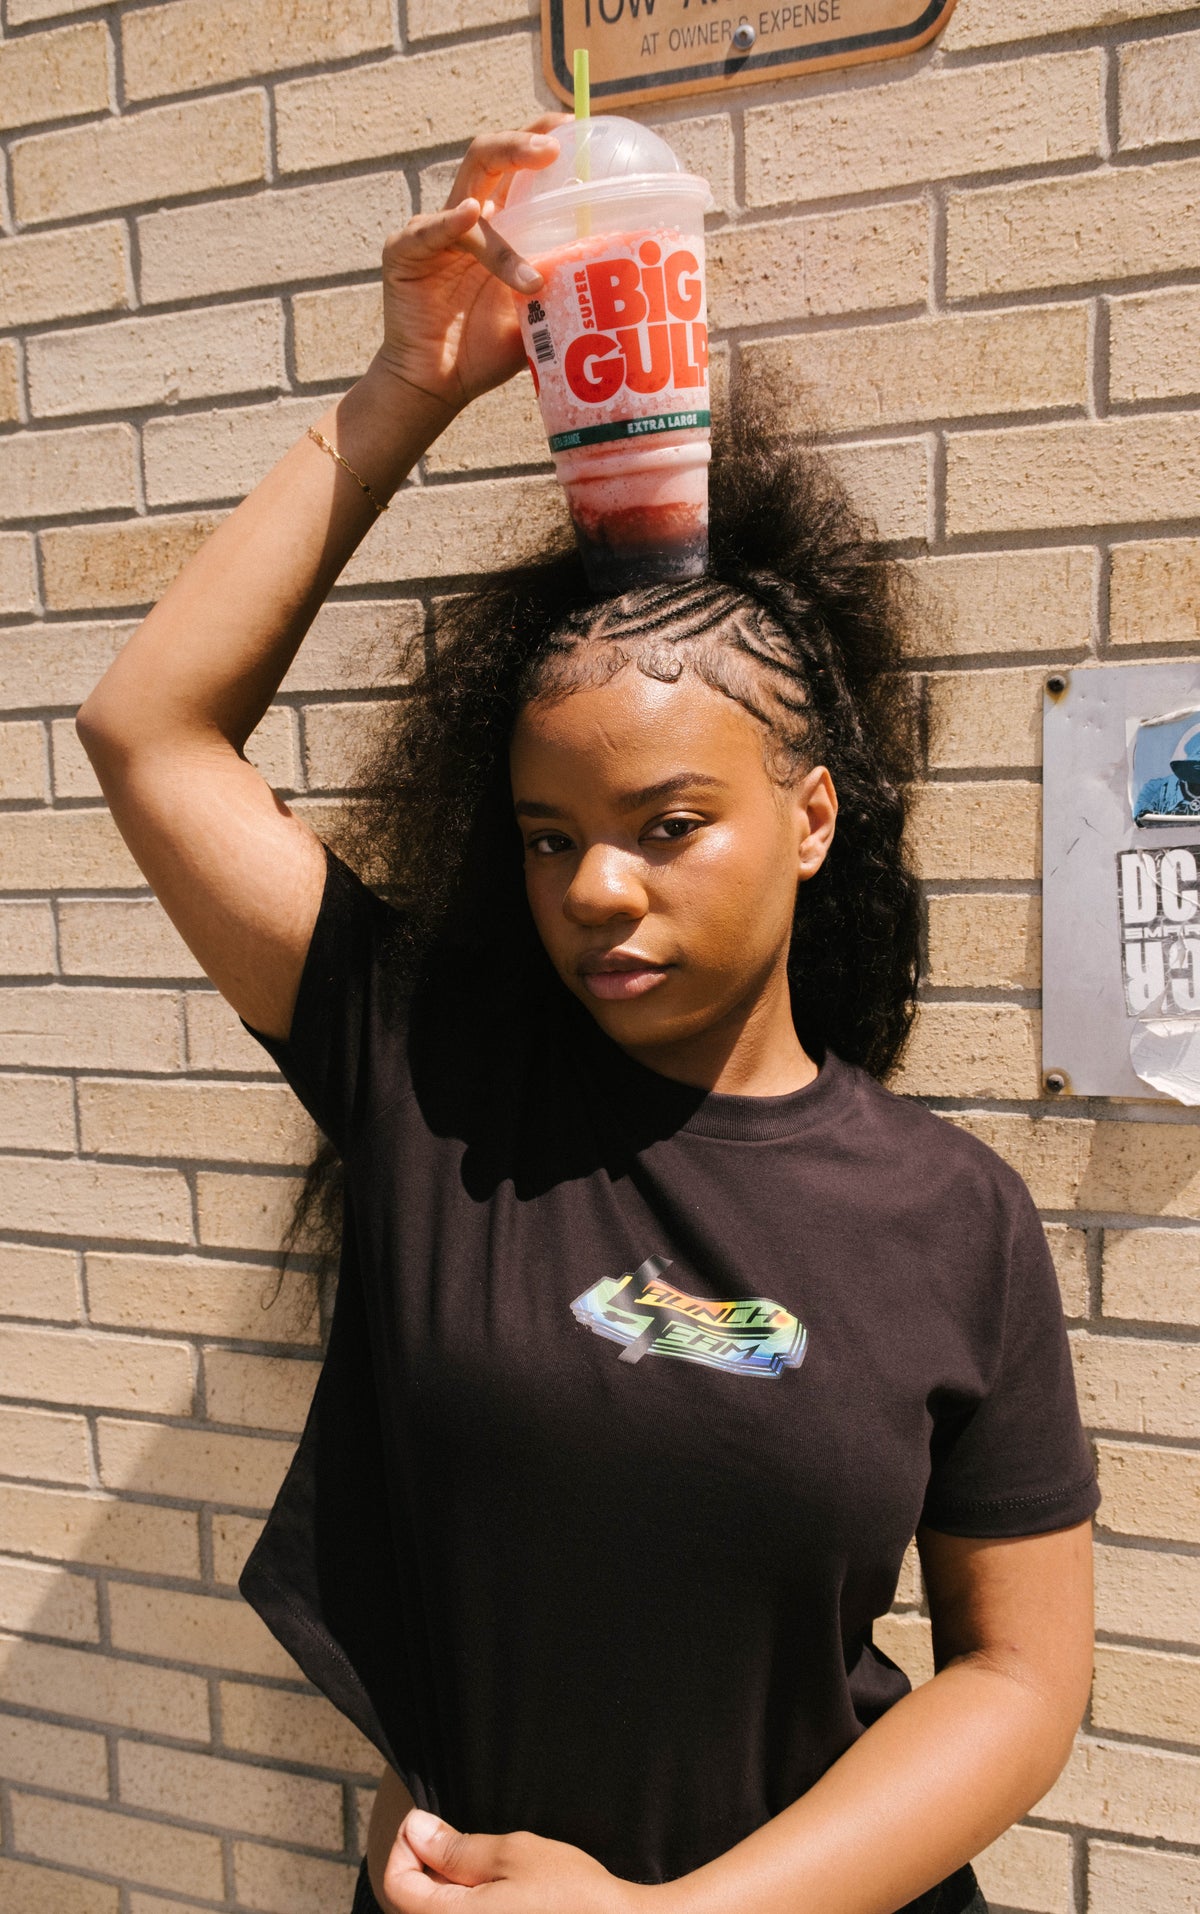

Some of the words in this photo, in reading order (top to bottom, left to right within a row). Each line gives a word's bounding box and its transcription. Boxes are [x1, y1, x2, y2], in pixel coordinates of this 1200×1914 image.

[641, 32, 660, 56] AT
[759, 0, 841, 35] EXPENSE
[528, 309, 546, 325] GULP
[573, 269, 596, 330] SUPER
[627, 417, 667, 434] EXTRA
[667, 413, 698, 428] LARGE
